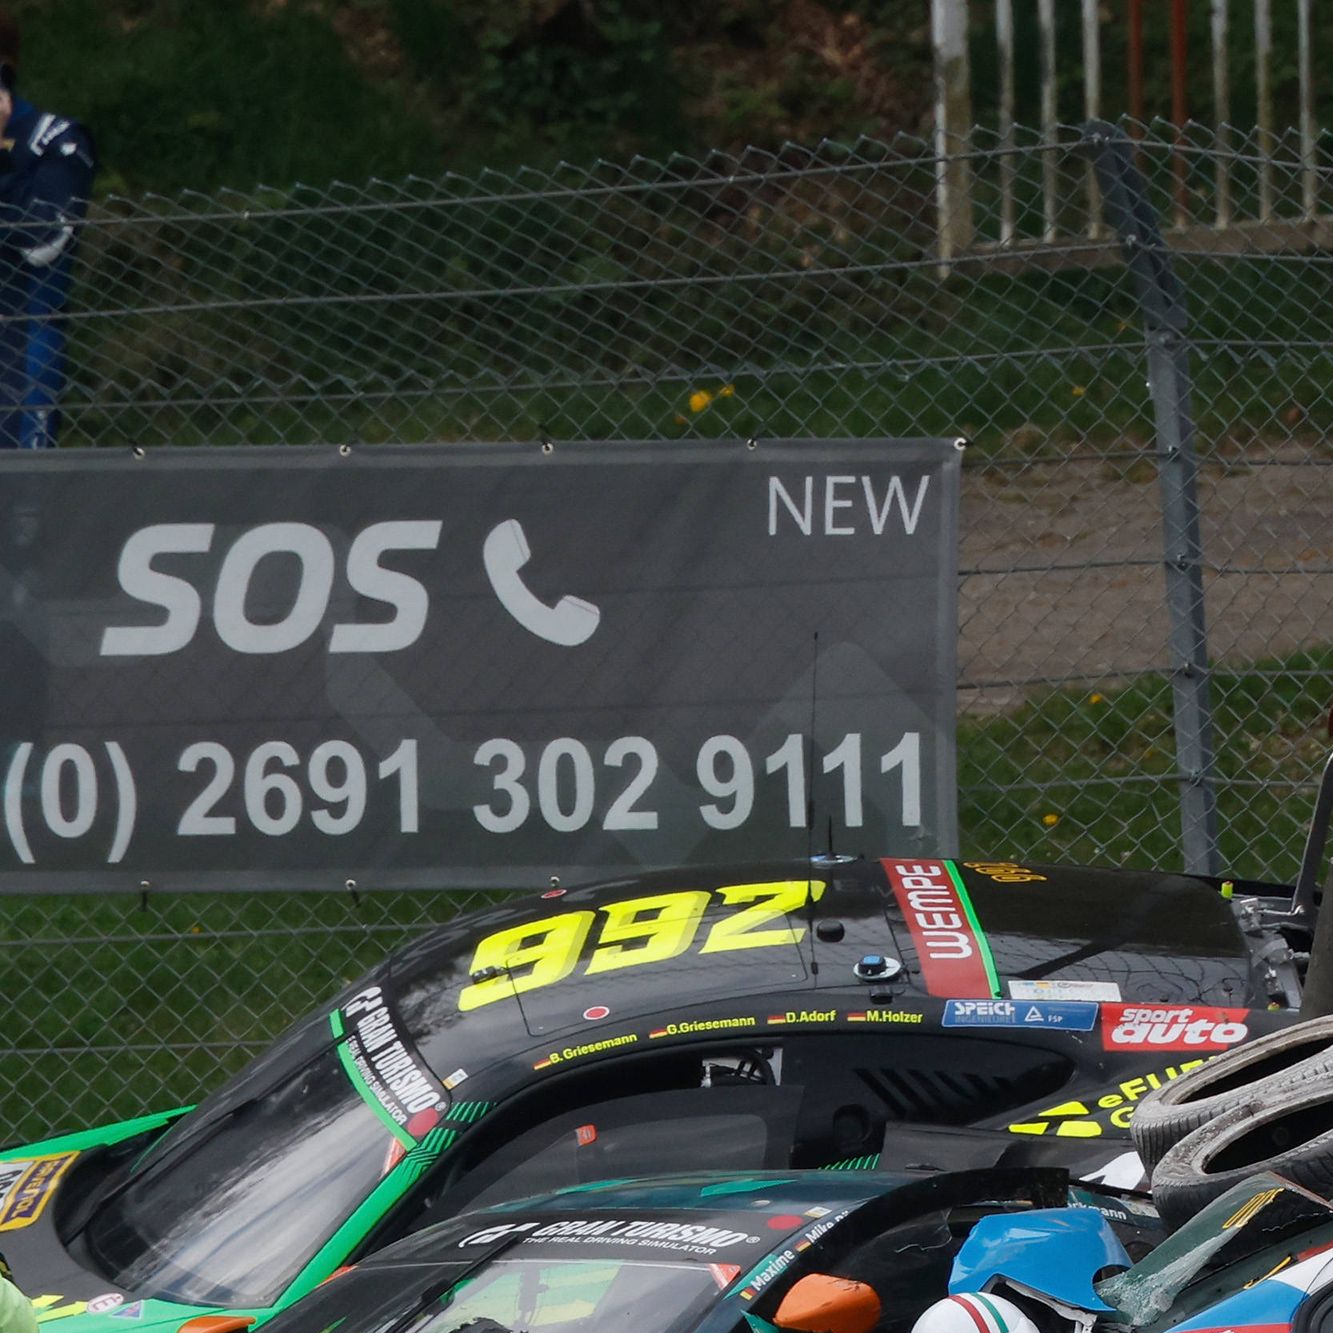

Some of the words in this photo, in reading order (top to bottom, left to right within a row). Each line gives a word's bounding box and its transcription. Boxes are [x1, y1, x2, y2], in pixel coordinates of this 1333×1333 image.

[768, 474, 931, 536] NEW
[99, 520, 443, 656] SOS
[4, 741, 137, 864] (0)
[176, 739, 420, 836] 2691
[472, 736, 660, 833] 302
[694, 733, 922, 831] 9111
[896, 864, 974, 960] WEMPE
[457, 879, 827, 1012] 992
[357, 1006, 398, 1053] GRAN
[1110, 1021, 1250, 1045] auto
[1119, 1007, 1192, 1026] sport
[550, 1052, 564, 1065] B.
[563, 1031, 638, 1061] Griesemann
[370, 1040, 441, 1114] TURISMO
[522, 1236, 546, 1244] THE
[549, 1236, 583, 1244] REAL
[583, 1237, 638, 1246] DRIVING
[637, 1239, 717, 1256] SIMULATOR
[531, 1220, 627, 1237] GRAN
[616, 1220, 748, 1248] TURISMO
[751, 1248, 796, 1292] Maxime
